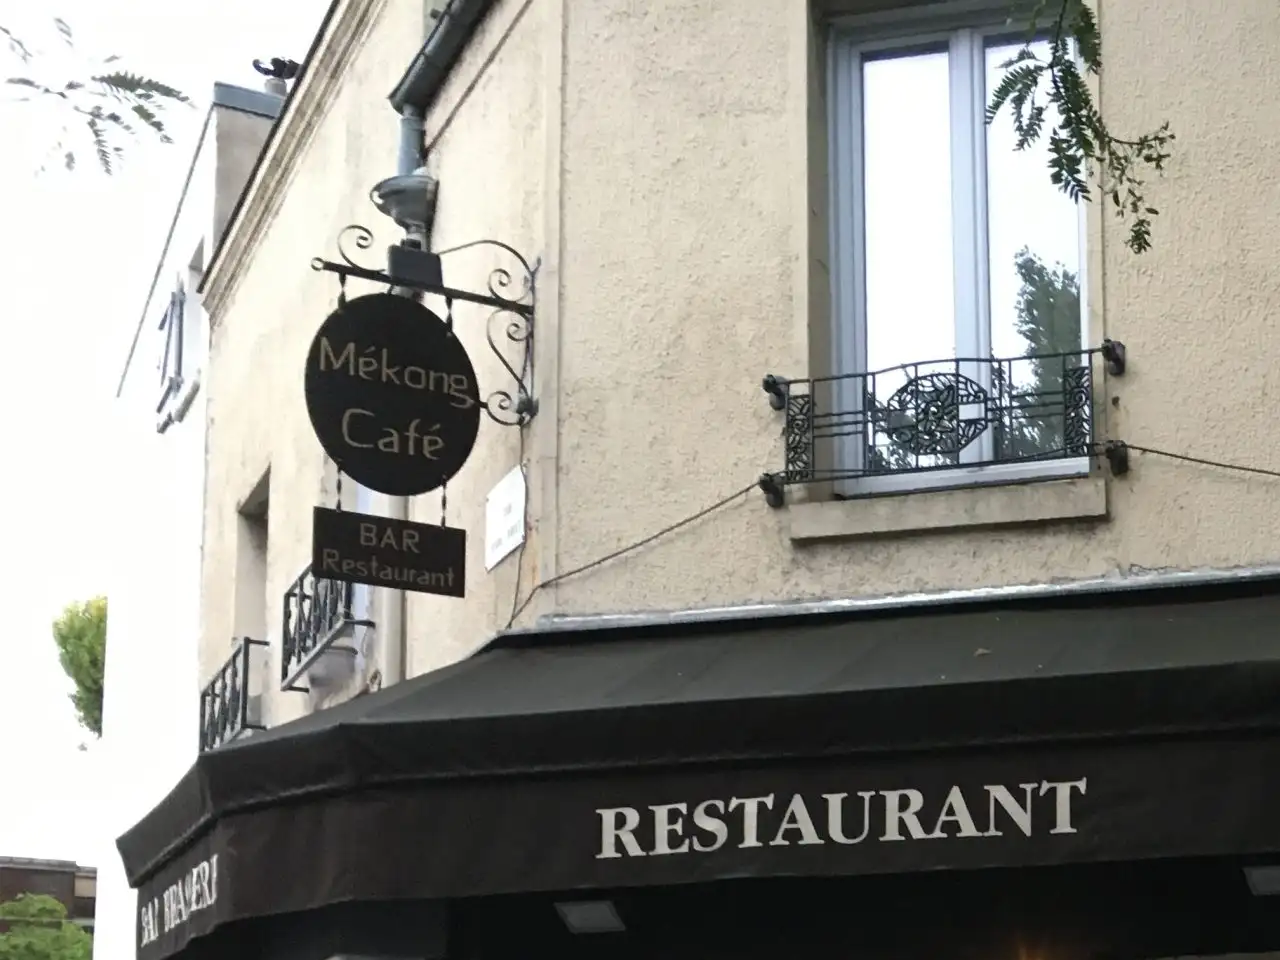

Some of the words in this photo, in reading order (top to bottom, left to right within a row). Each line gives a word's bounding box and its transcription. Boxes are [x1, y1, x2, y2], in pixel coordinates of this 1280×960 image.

[318, 335, 476, 409] Mékong
[341, 407, 446, 460] Café
[359, 522, 421, 553] BAR
[321, 548, 456, 588] Restaurant
[595, 777, 1088, 860] RESTAURANT
